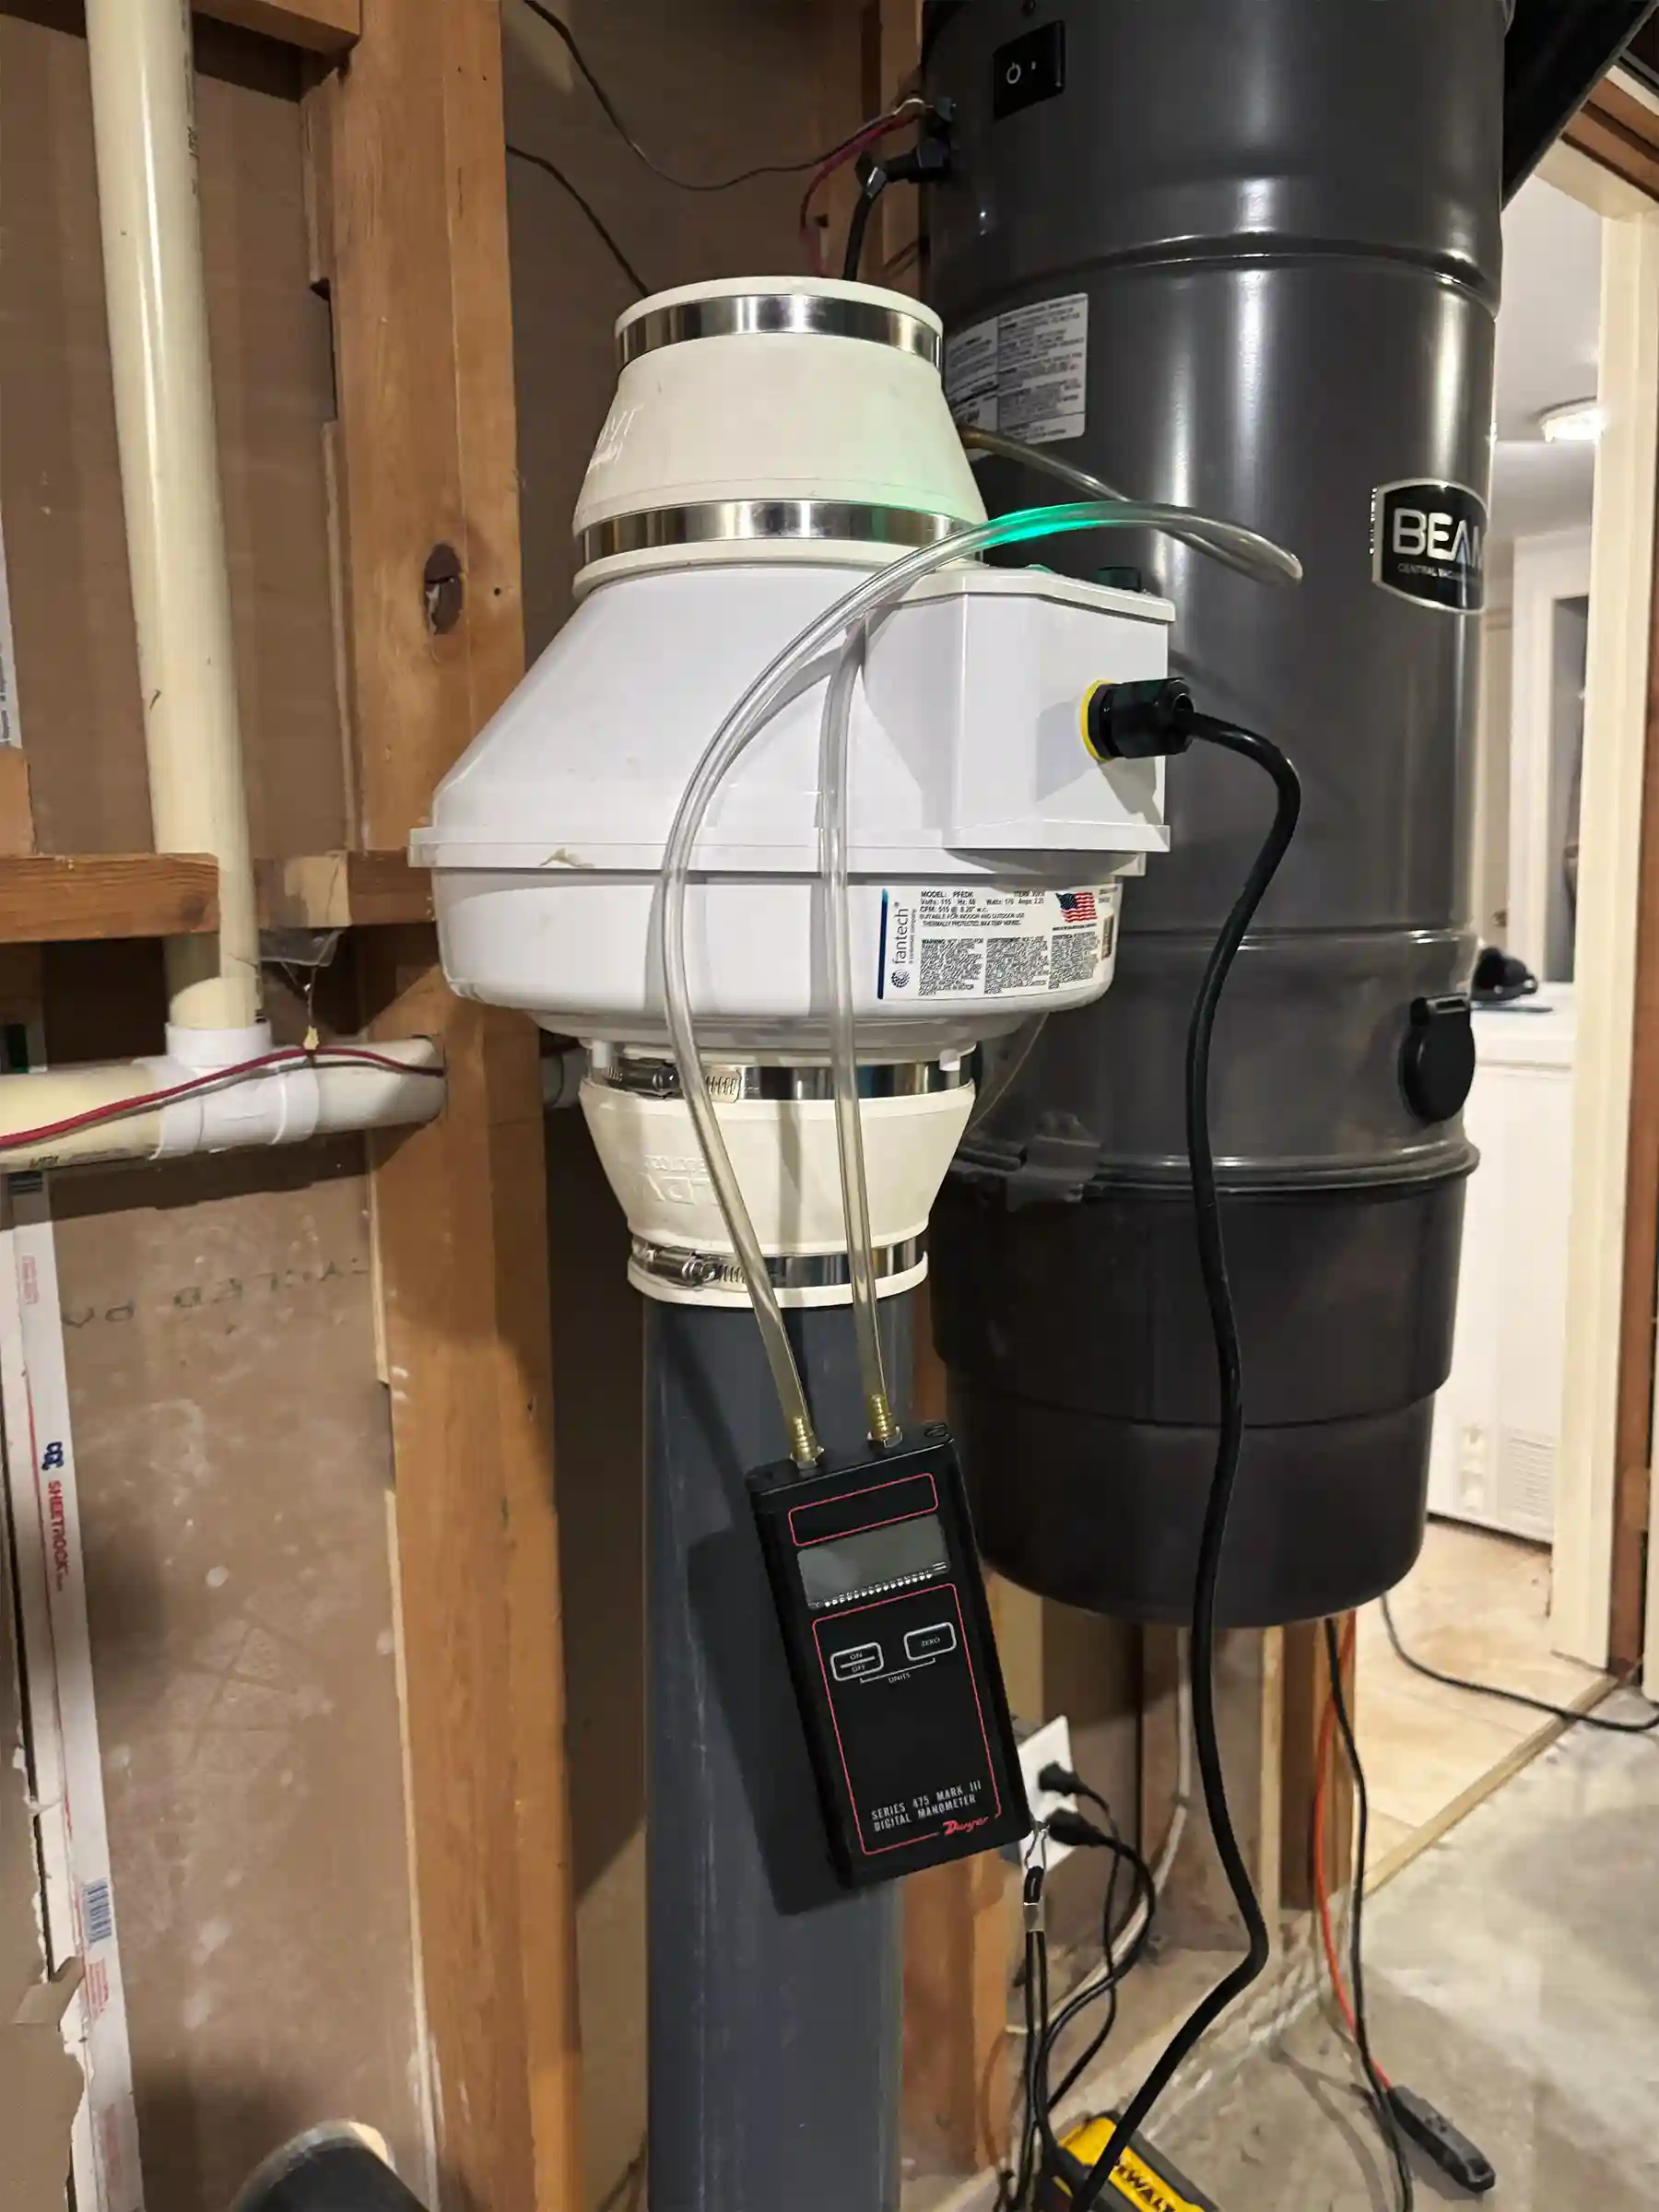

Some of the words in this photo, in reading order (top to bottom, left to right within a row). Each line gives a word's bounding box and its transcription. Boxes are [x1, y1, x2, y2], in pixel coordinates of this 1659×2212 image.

[892, 909, 909, 964] fantech
[48, 1480, 69, 1572] SHEETROCK
[921, 1636, 941, 1648] ZERO
[850, 1652, 863, 1660] ON
[851, 1665, 865, 1673] OFF
[888, 1672, 912, 1685] UNITS
[871, 1802, 906, 1821] SERIES
[912, 1795, 930, 1809] 475
[936, 1784, 963, 1802] MARK
[969, 1780, 982, 1793] III
[874, 1813, 912, 1832] DIGITAL
[917, 1793, 977, 1819] MANOMETER
[942, 1816, 990, 1836] Dwyer
